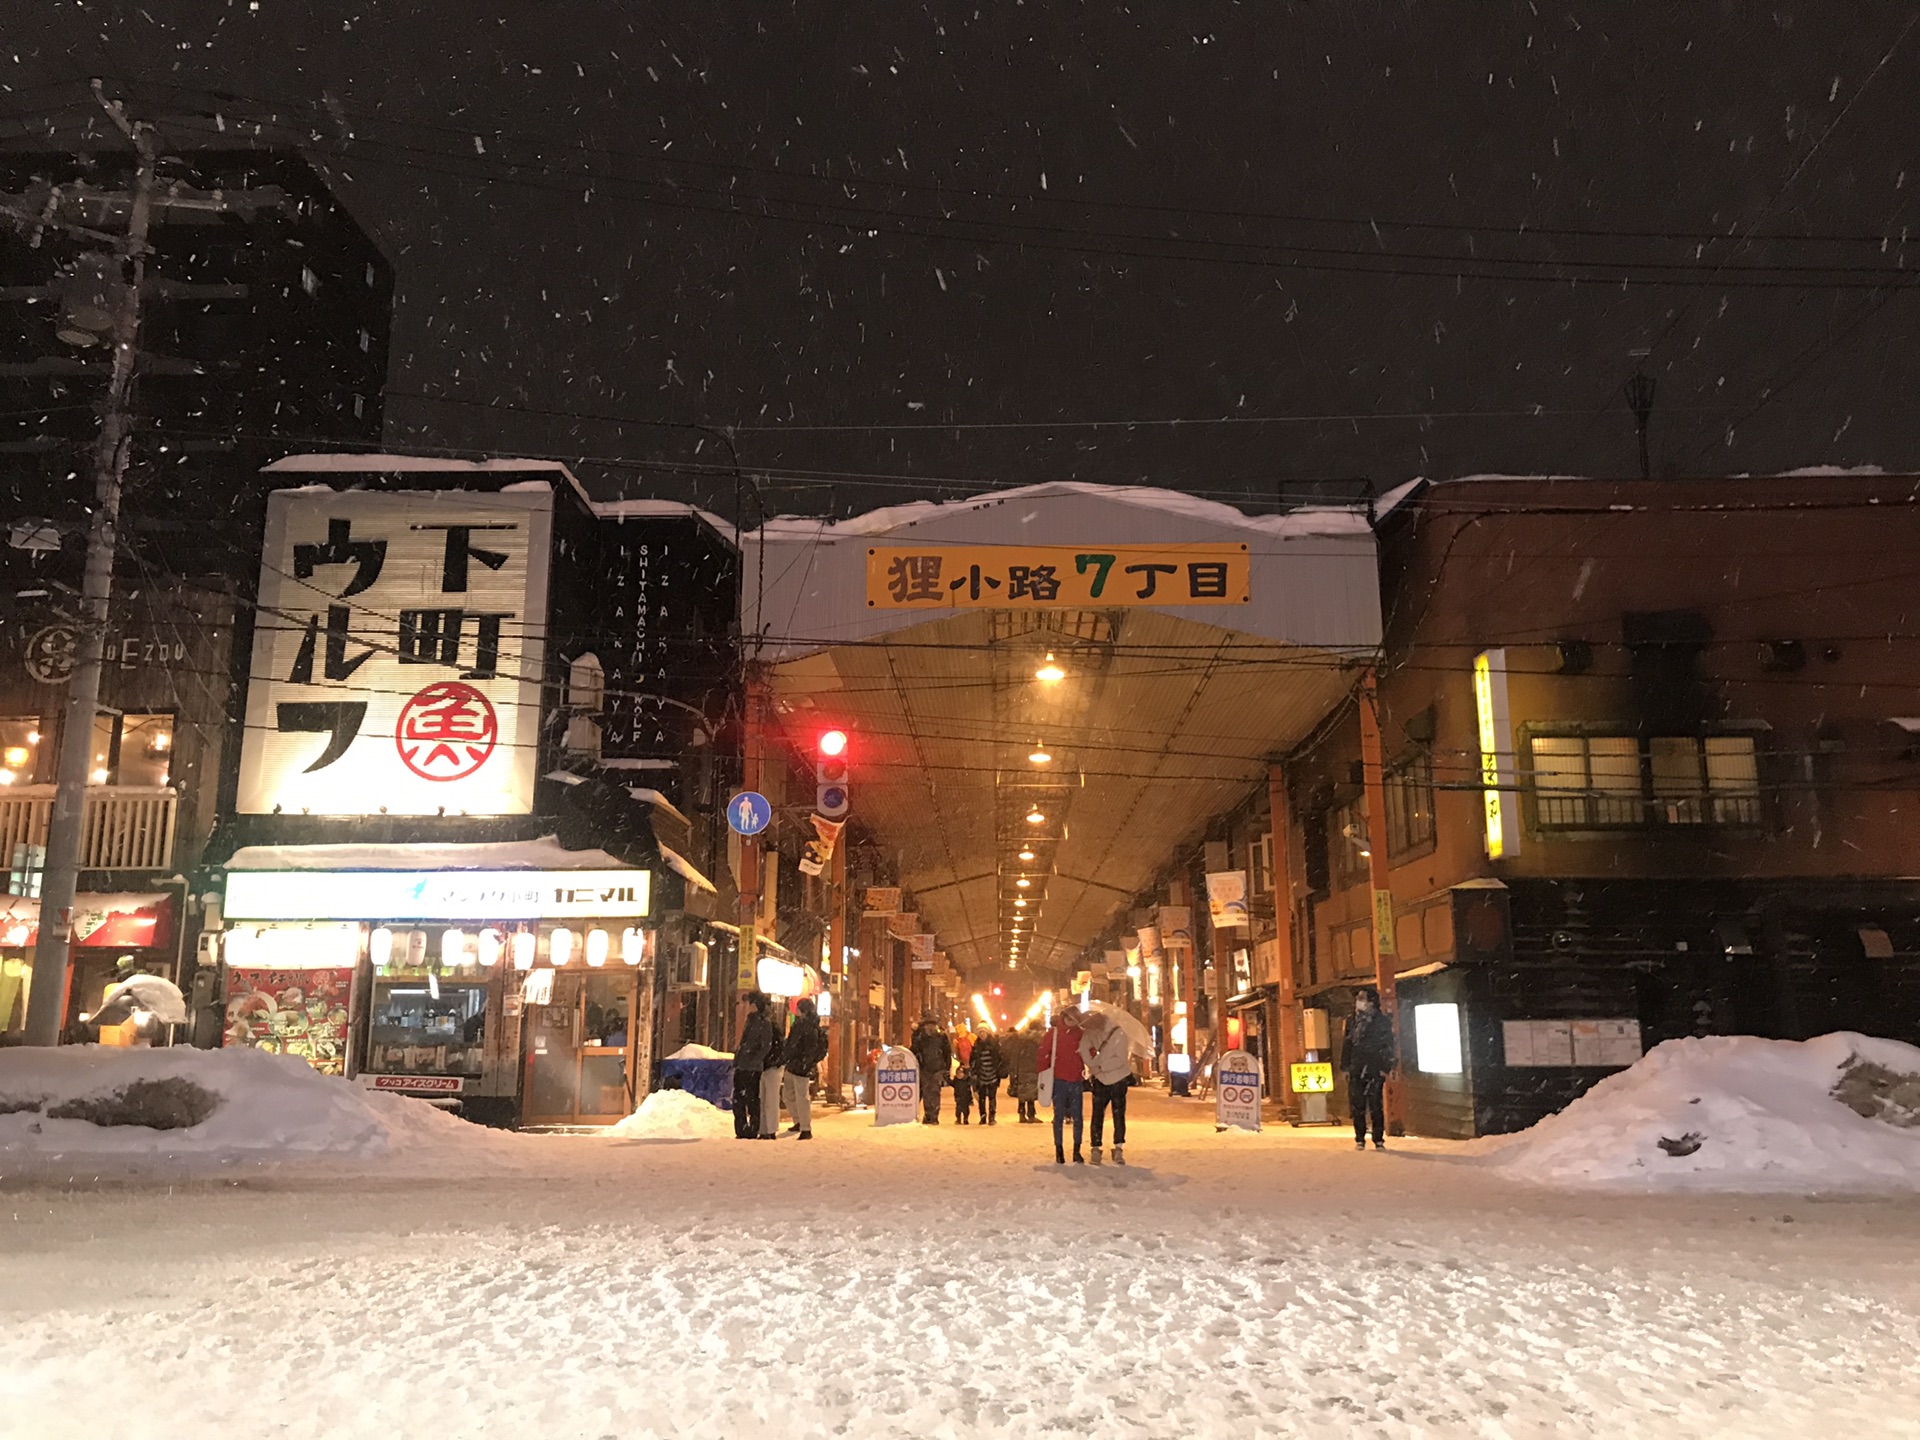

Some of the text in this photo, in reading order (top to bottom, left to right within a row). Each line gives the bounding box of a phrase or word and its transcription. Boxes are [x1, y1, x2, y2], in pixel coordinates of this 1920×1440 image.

[276, 518, 389, 775] ウルフ
[399, 522, 518, 681] 下町
[610, 544, 626, 743] IZAKAYA
[634, 544, 649, 664] SHITAMACHI
[654, 544, 670, 743] IZAKAYA
[887, 553, 1228, 603] 狸小路7丁目
[554, 886, 638, 904] カニマル
[381, 1077, 455, 1089] グリコアイスクリーム
